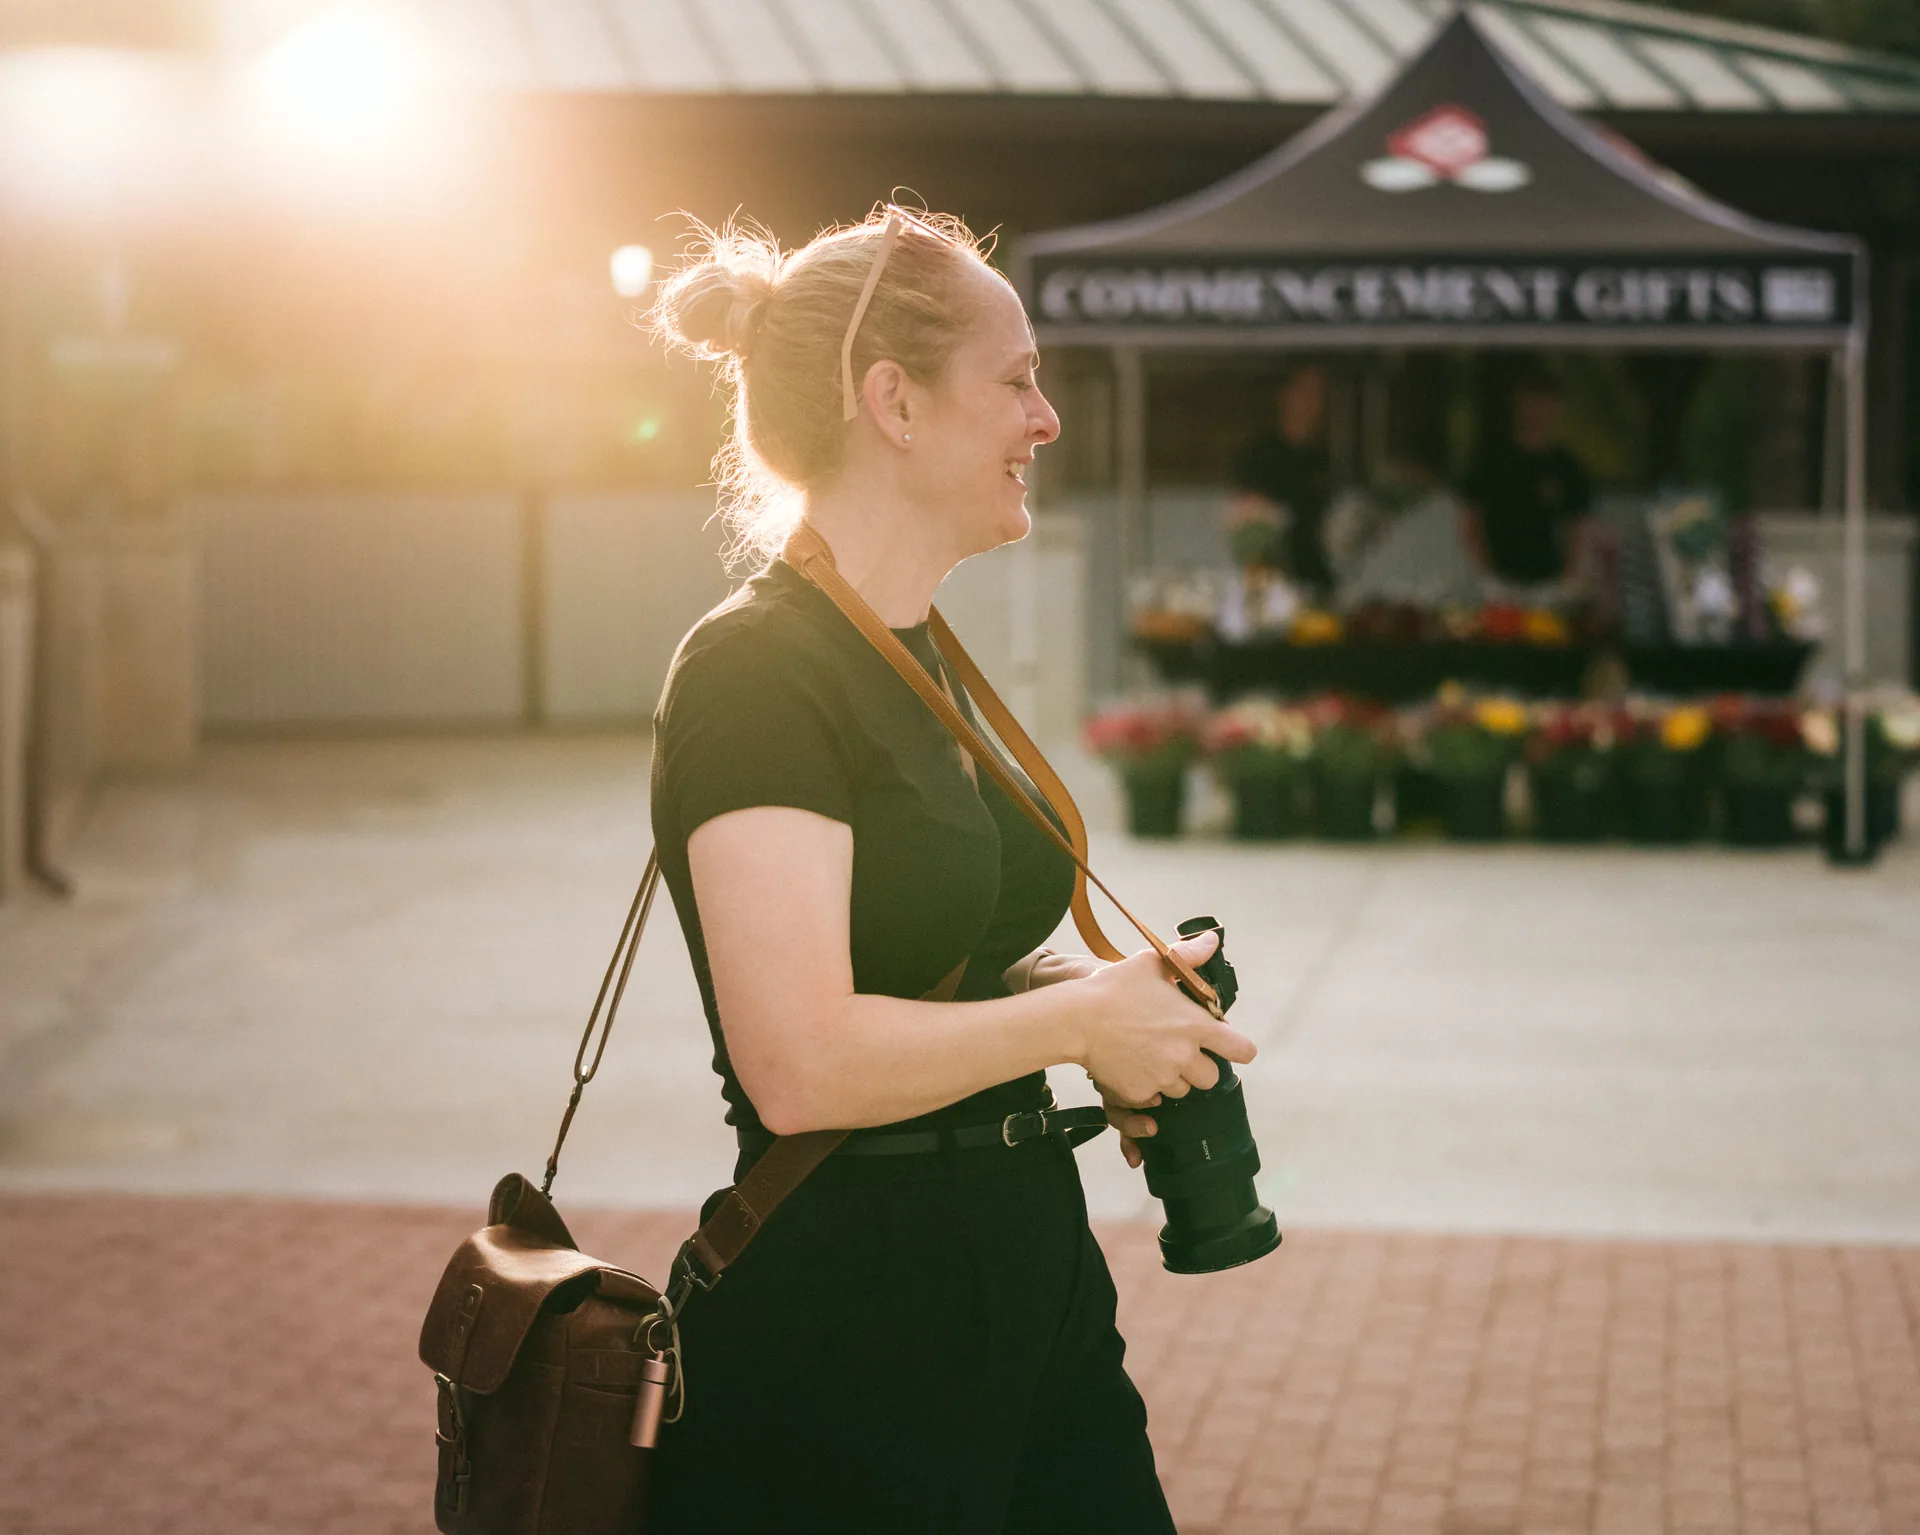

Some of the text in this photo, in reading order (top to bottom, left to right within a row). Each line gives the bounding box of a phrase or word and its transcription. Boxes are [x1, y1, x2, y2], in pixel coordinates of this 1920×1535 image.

[1040, 268, 1563, 320] COMMENCEMENT
[1574, 268, 1754, 321] GIFTS
[1201, 1139, 1212, 1161] SONY
